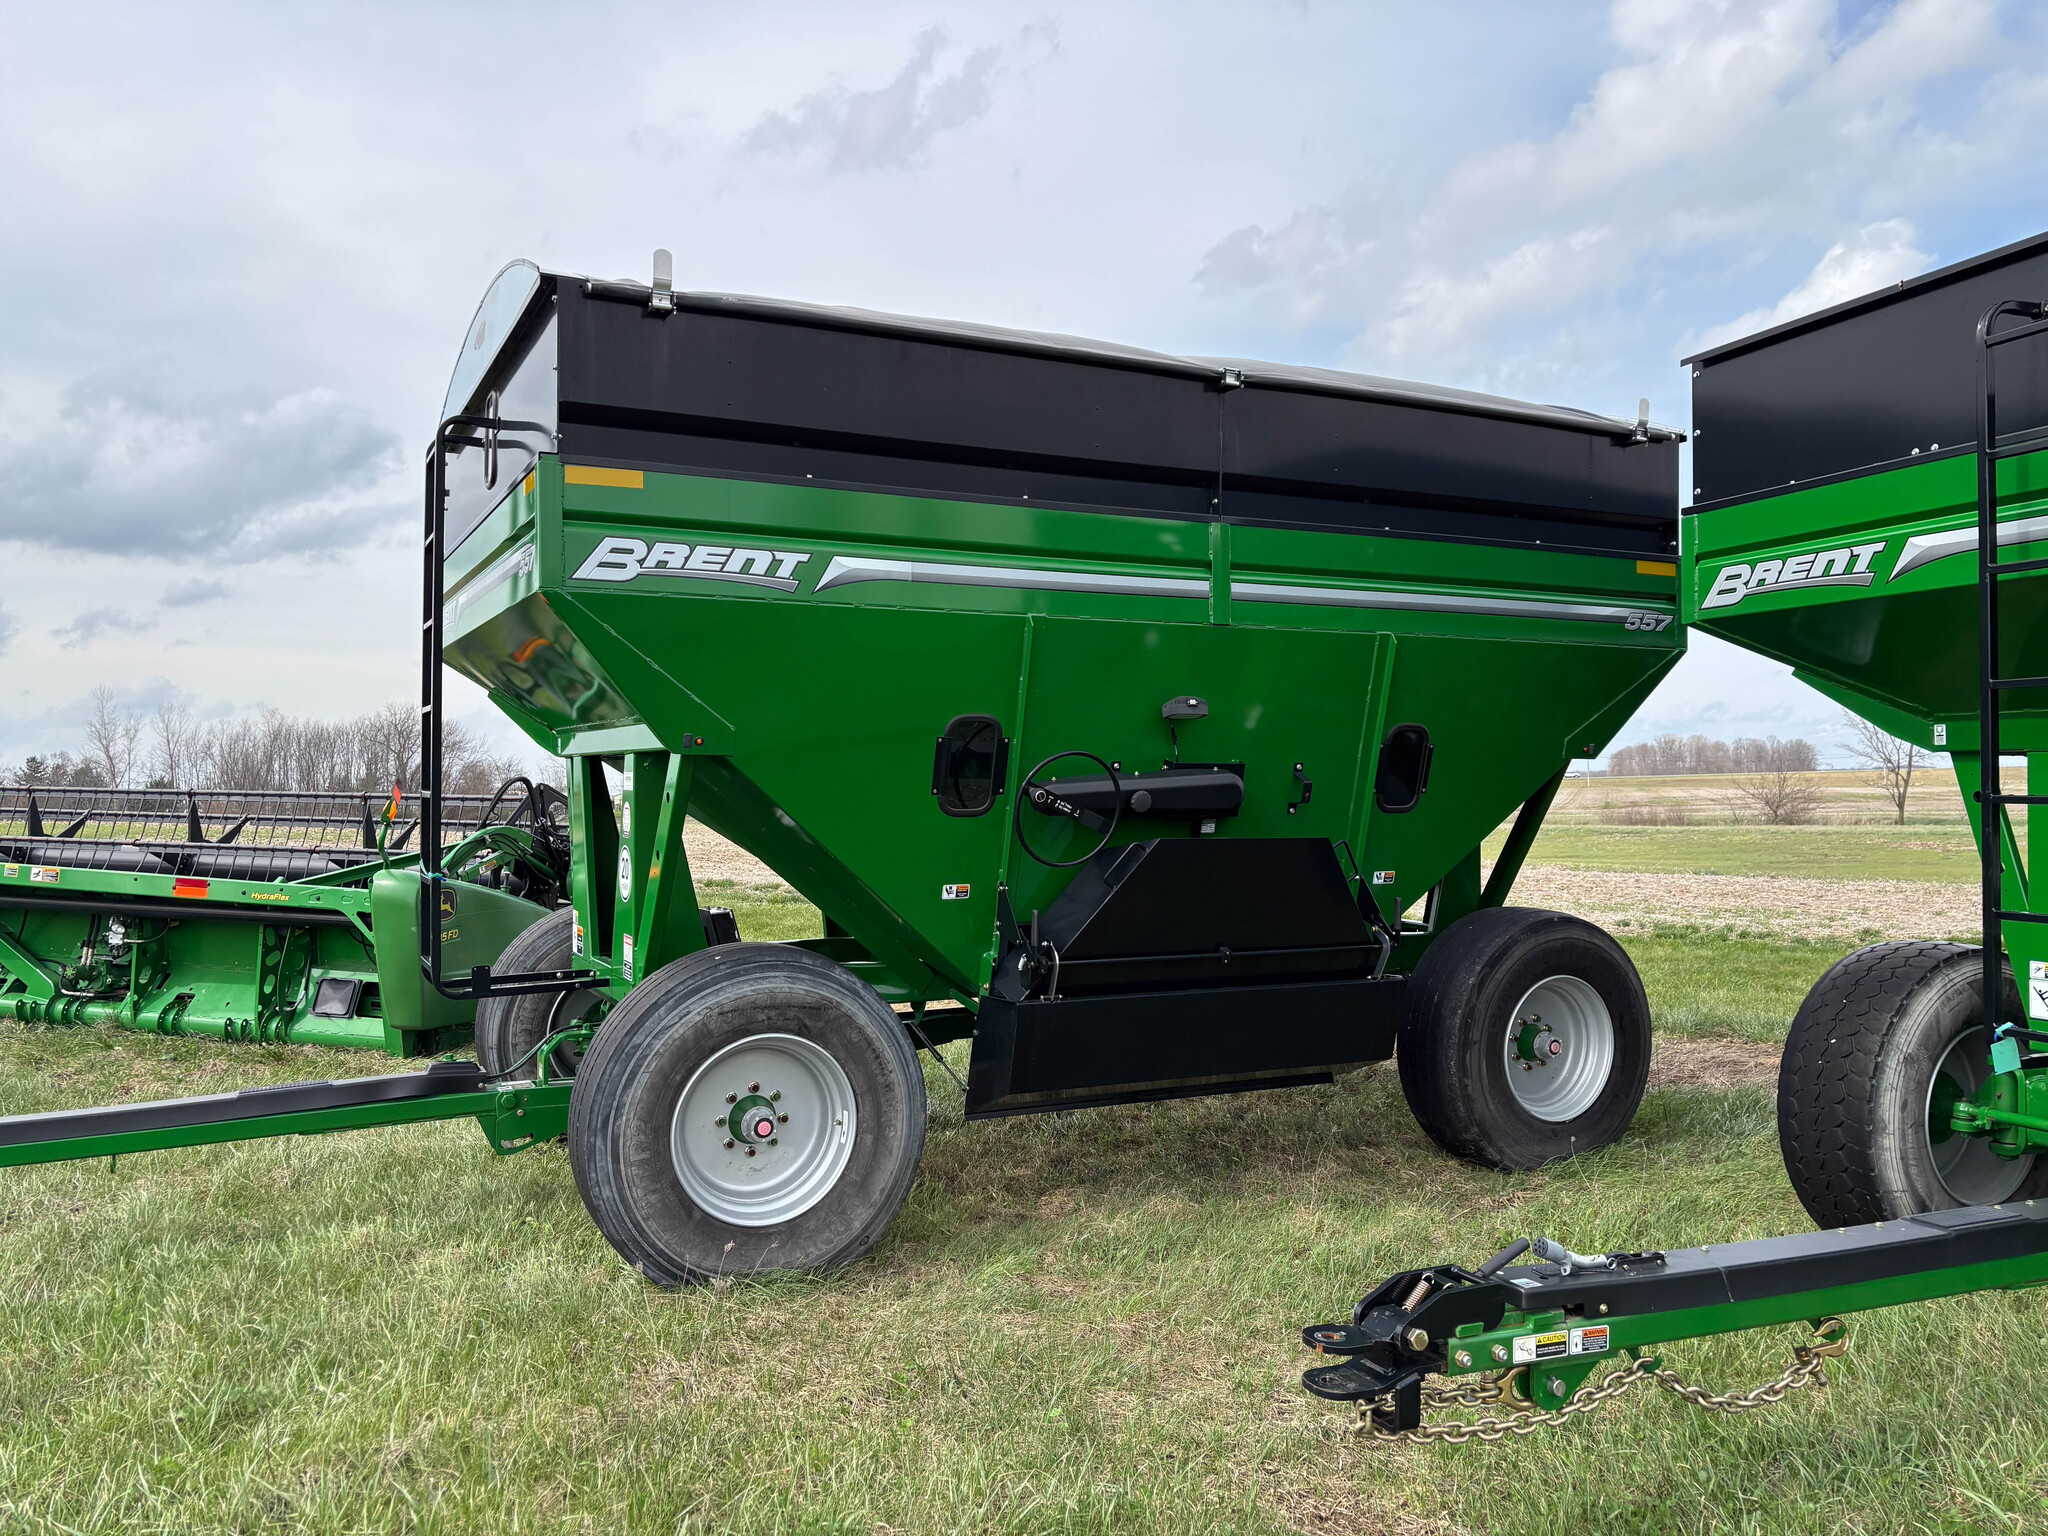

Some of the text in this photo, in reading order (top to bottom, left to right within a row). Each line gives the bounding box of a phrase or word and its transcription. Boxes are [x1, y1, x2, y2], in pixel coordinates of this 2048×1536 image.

[568, 536, 814, 585] BRENT
[1700, 541, 1889, 610] BRENT
[1624, 612, 1674, 632] 557
[621, 857, 630, 881] 20
[250, 891, 290, 902] HydraFlex
[1543, 1334, 1566, 1343] CAUTION
[1588, 1328, 1607, 1336] WARNING
